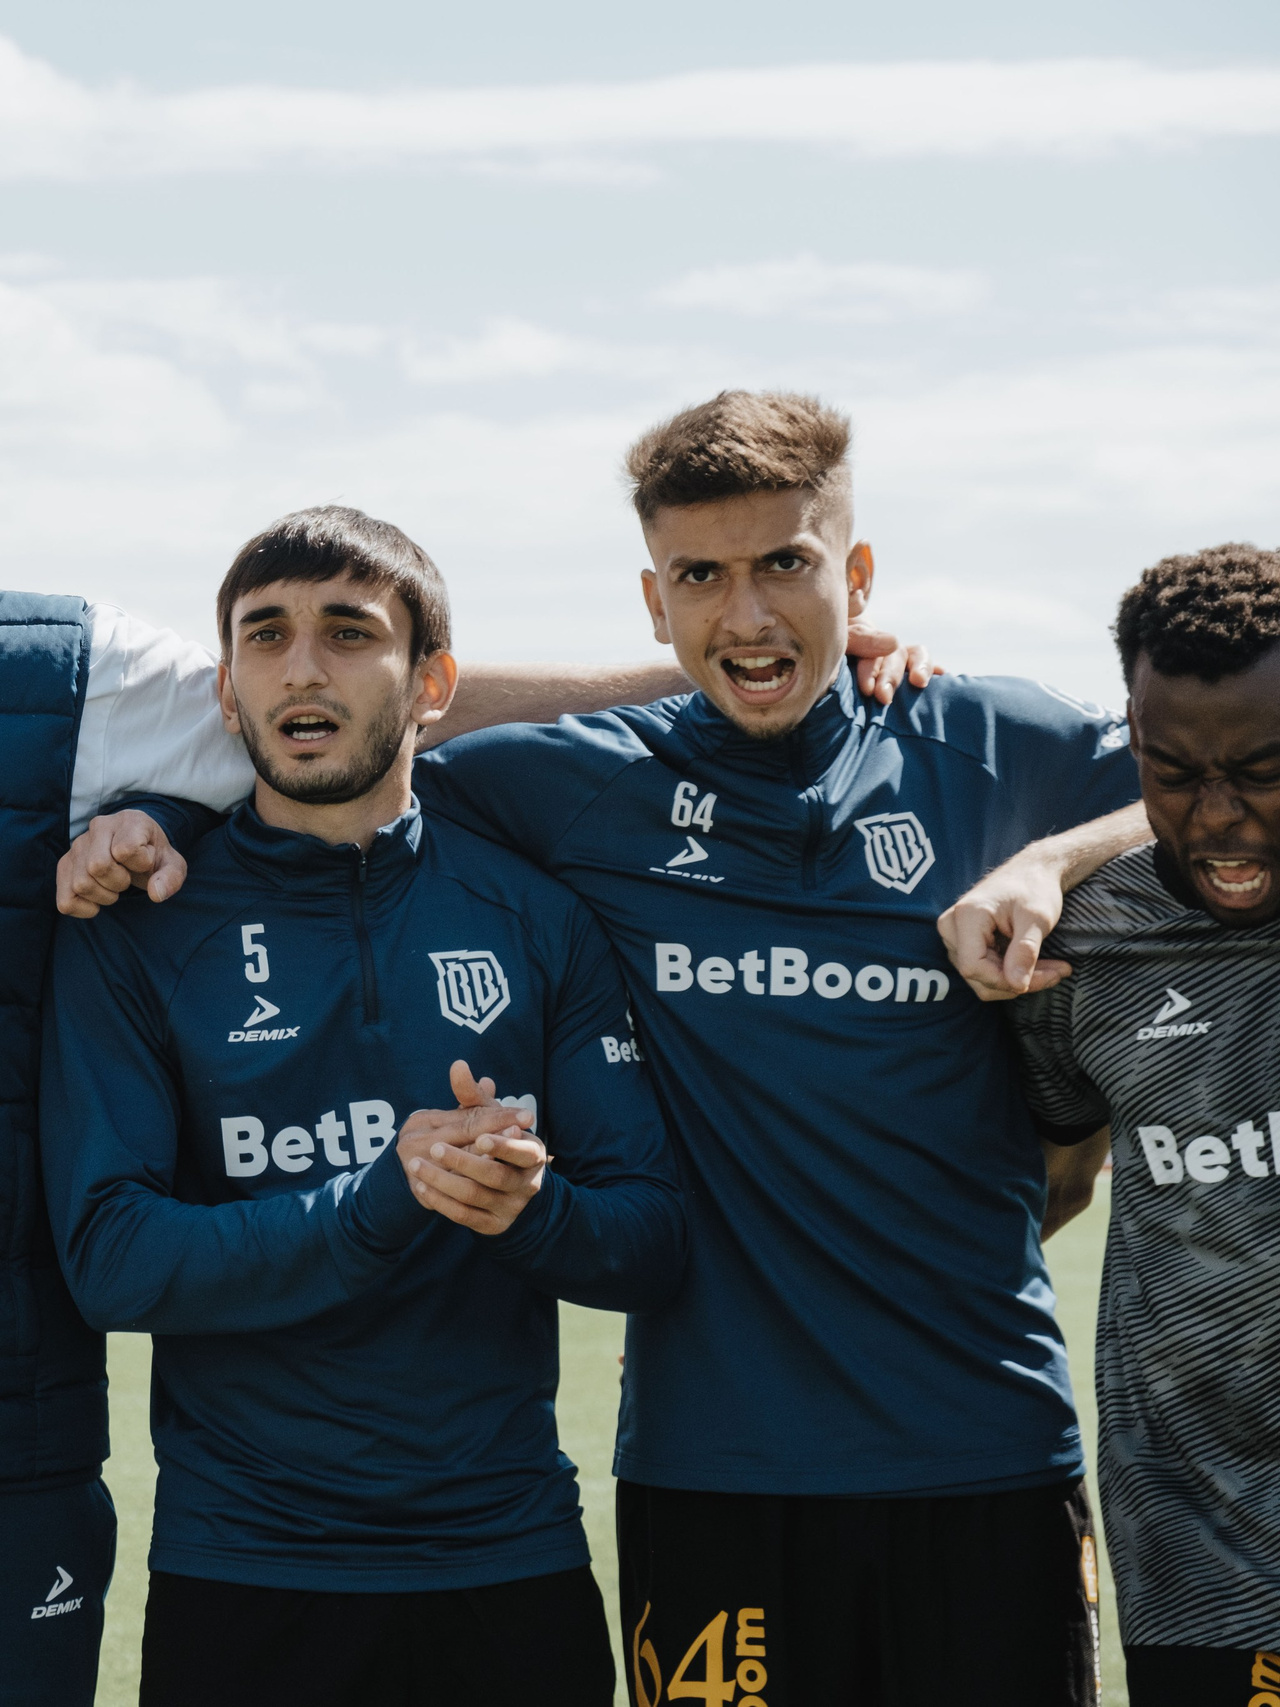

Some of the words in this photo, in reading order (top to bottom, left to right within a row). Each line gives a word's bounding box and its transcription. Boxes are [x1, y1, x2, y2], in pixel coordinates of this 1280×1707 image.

[671, 781, 718, 833] 64
[241, 923, 270, 983] 5
[655, 942, 951, 1003] BetBoom
[227, 1026, 301, 1043] DEMIX
[1136, 1021, 1213, 1041] DEMIX
[601, 1036, 644, 1063] Bet
[30, 1596, 84, 1620] DEMIX
